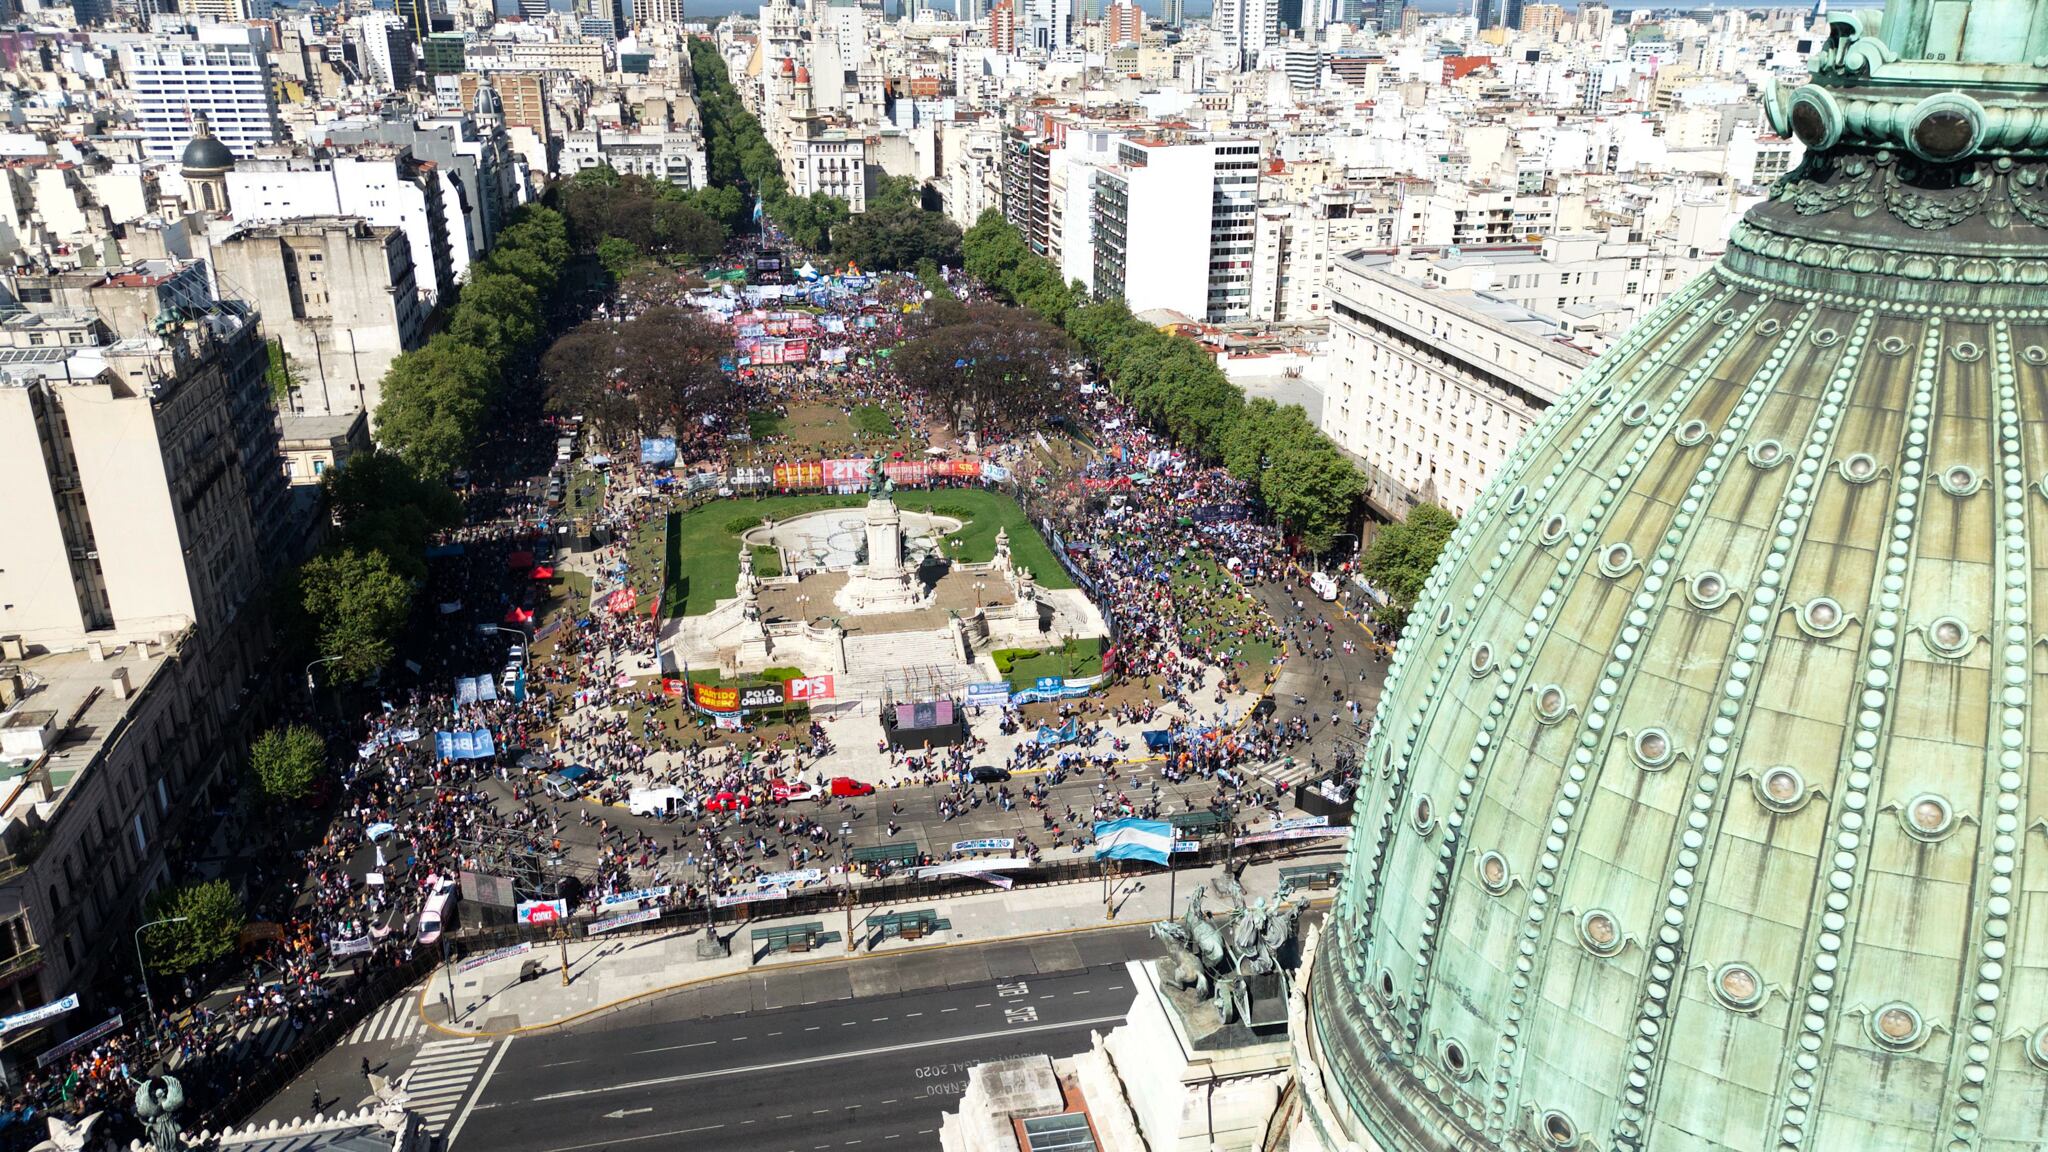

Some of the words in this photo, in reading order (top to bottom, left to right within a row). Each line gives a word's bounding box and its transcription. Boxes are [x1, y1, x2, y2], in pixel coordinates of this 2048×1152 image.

[745, 688, 776, 698] POLO
[792, 677, 826, 697] PTS
[698, 687, 736, 700] PARTIDO
[699, 698, 735, 708] OBRERO
[741, 695, 784, 706] OBRERO
[532, 910, 553, 922] COOKE
[915, 1064, 948, 1078] 2020
[926, 1080, 970, 1096] ENADO
